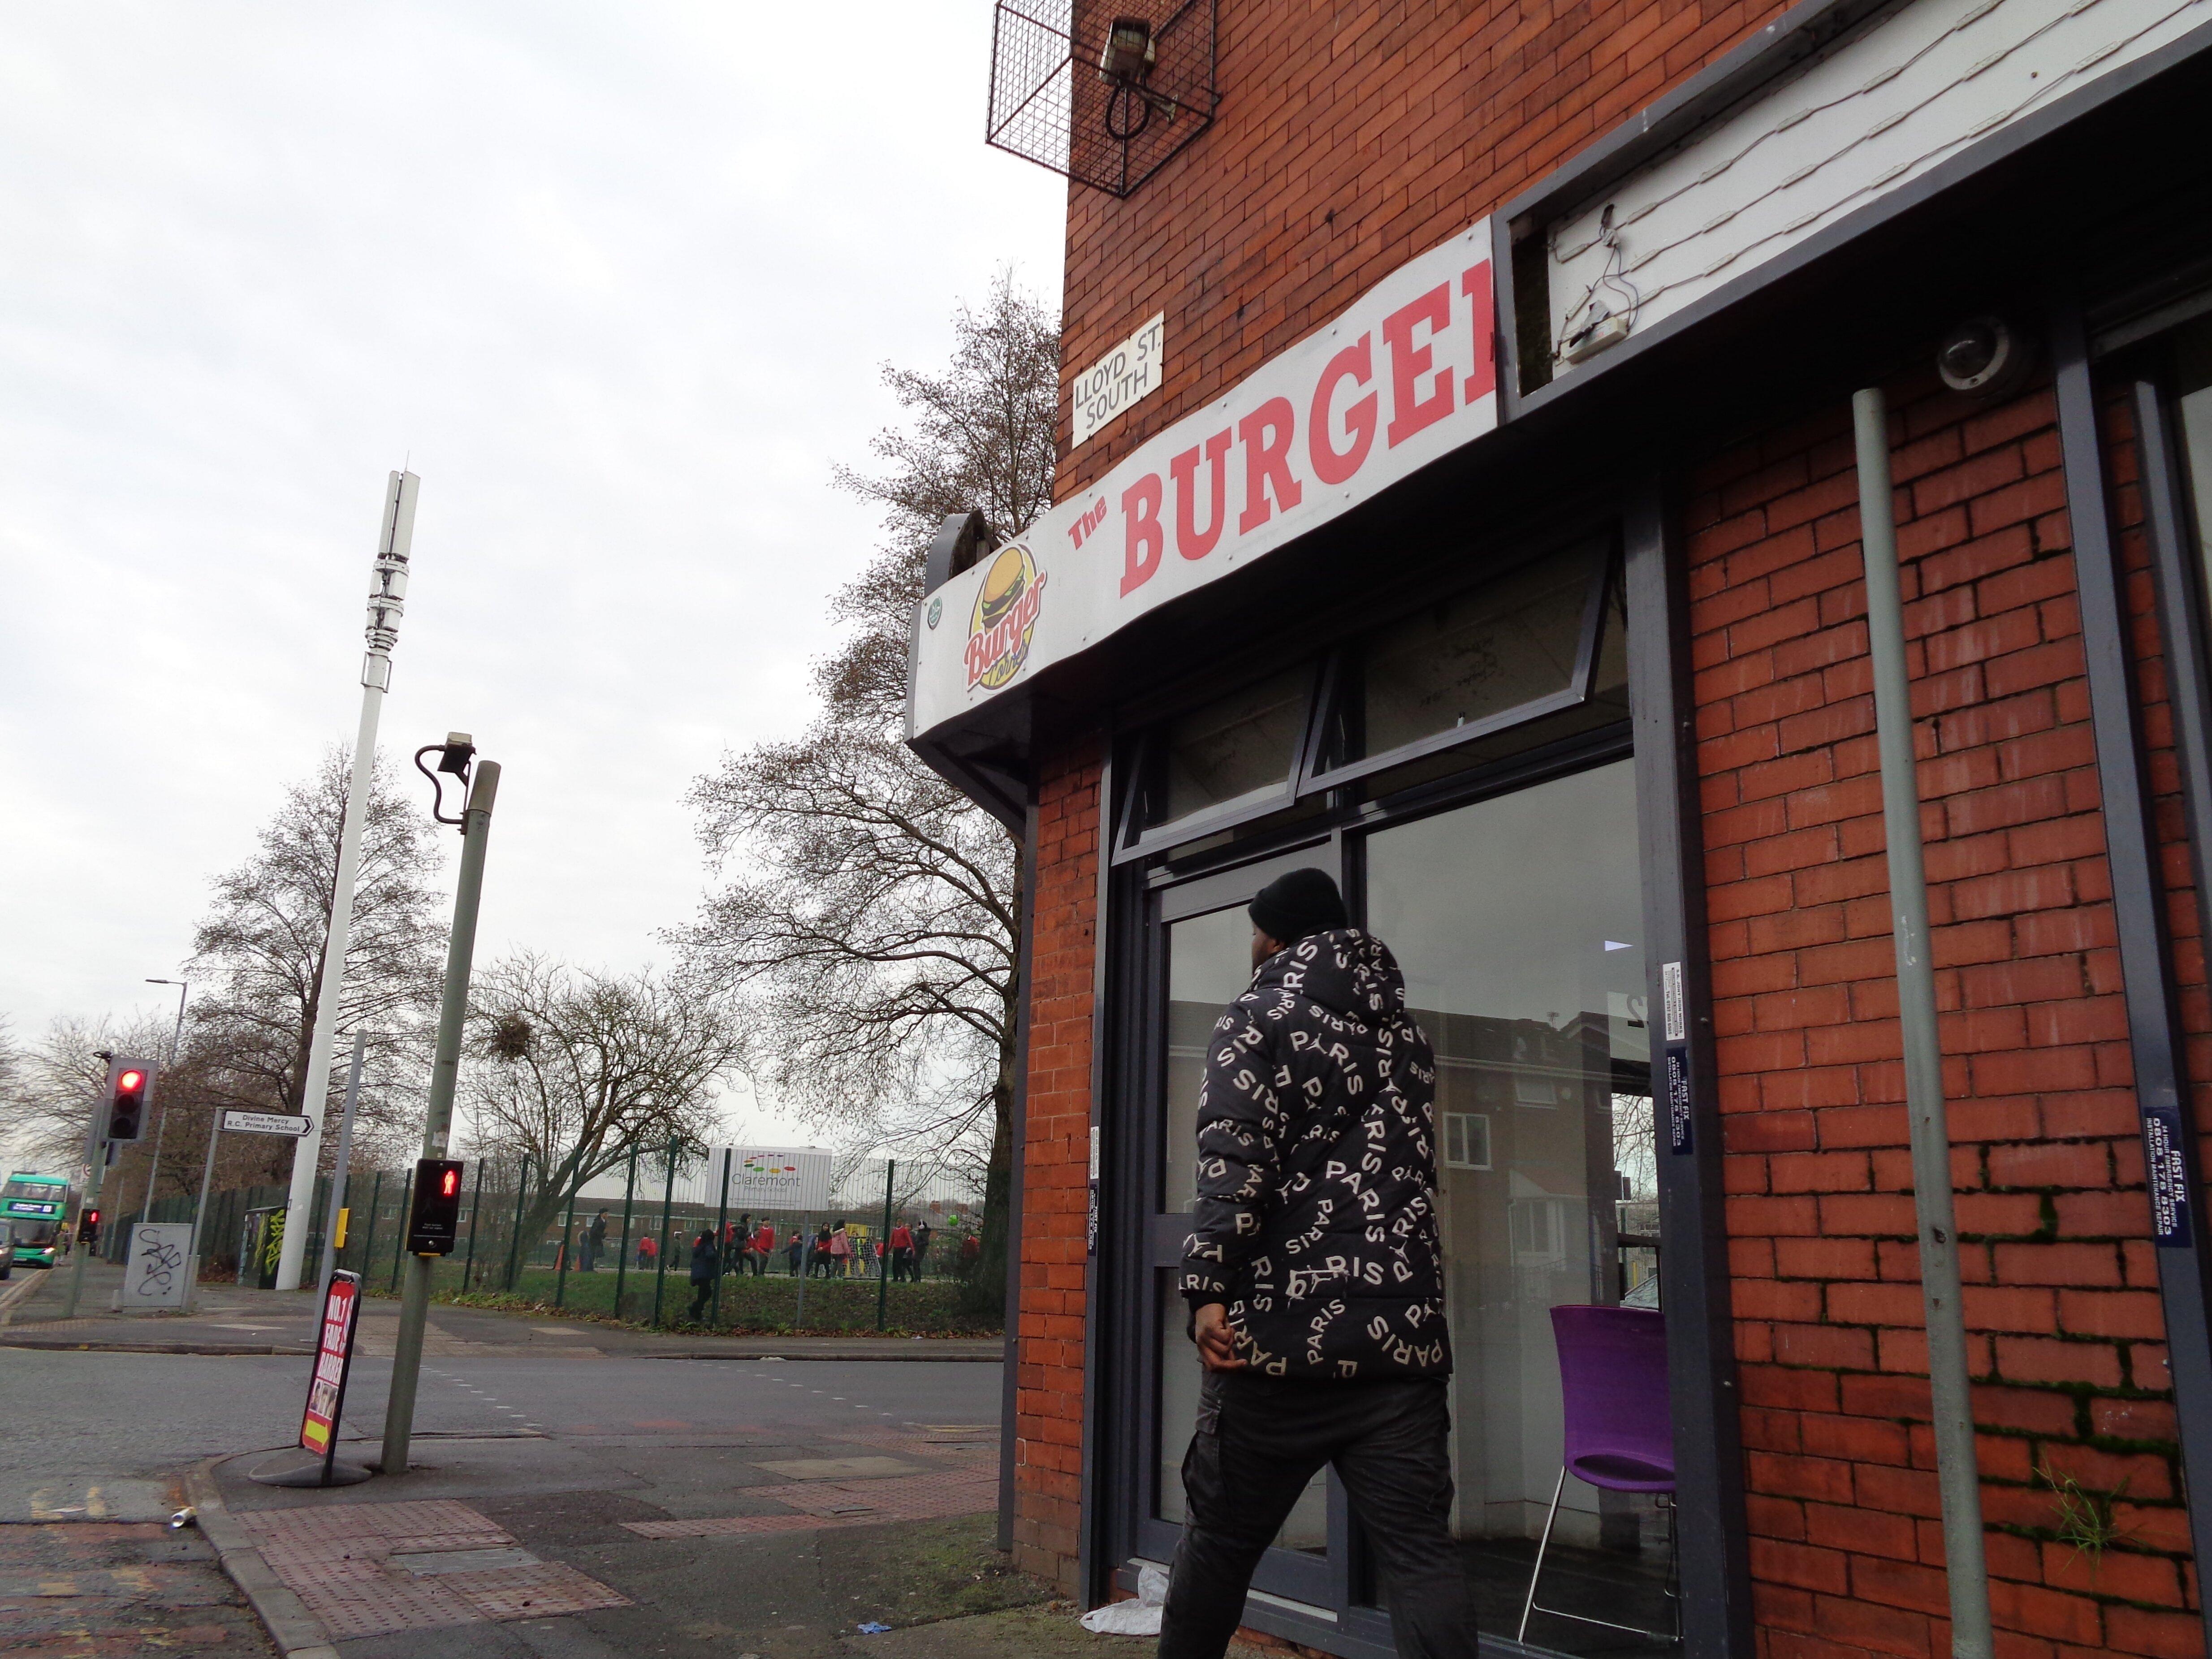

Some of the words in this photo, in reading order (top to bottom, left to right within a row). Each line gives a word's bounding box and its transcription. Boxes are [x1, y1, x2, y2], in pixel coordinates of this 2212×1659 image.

[1076, 351, 1126, 410] LLOYD
[1137, 323, 1161, 361] ST.
[1086, 362, 1148, 429] SOUTH
[1068, 495, 1107, 550] The
[964, 572, 1045, 687] Burger
[1283, 941, 1319, 994] RIS
[1290, 1031, 1363, 1095] PARIS
[245, 1122, 273, 1130] Primary
[2147, 1118, 2156, 1162] INSTALLATION
[2153, 1118, 2163, 1156] 0808
[732, 1173, 801, 1187] Claremont
[2151, 1164, 2161, 1210] MAINTENANCE
[2158, 1162, 2166, 1190] 178
[2165, 1155, 2174, 1196] EMERGENCY
[2171, 1150, 2182, 1179] FAST
[1326, 1161, 1386, 1243] PARIS
[2169, 1198, 2177, 1227] SERVICE
[2174, 1183, 2186, 1202] FIX
[1285, 1199, 1334, 1254] PARIS
[2161, 1196, 2172, 1235] 8303
[1389, 1197, 1427, 1283] PARIS
[328, 1294, 348, 1322] NO.1
[323, 1323, 343, 1352] FADE
[1307, 1299, 1346, 1365] PARIS
[1367, 1316, 1443, 1367] PARIS
